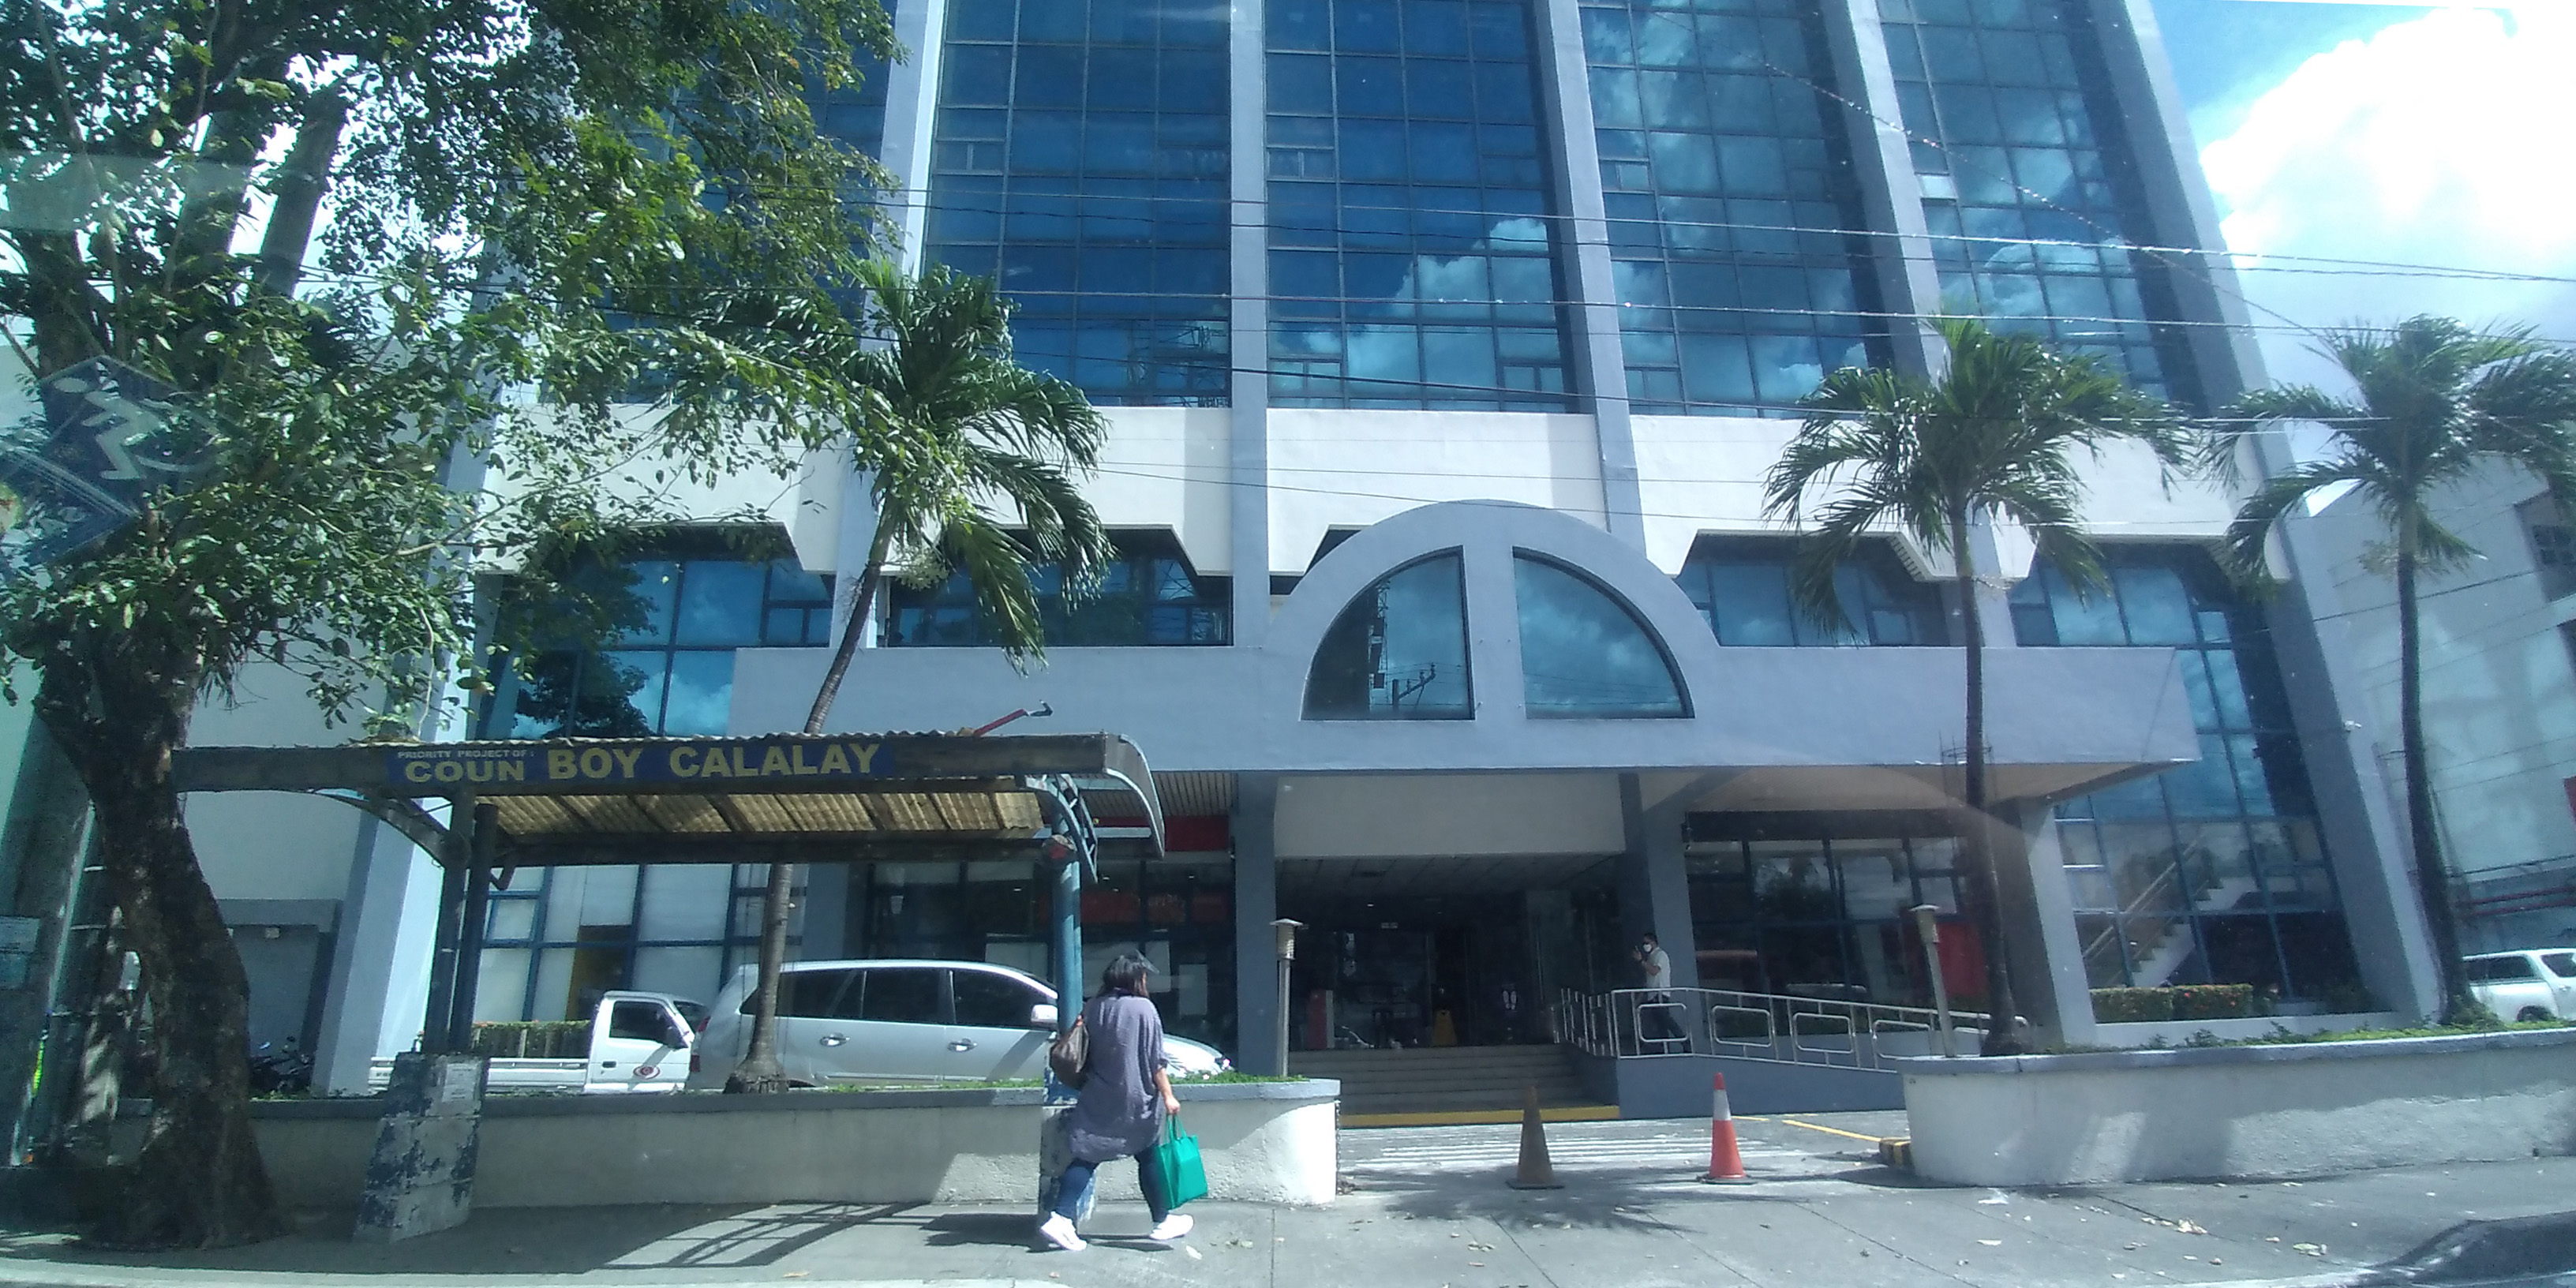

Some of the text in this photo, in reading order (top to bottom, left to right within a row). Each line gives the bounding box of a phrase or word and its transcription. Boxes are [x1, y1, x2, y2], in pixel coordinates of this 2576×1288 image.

[405, 743, 879, 783] COUN BOY CALALAY
